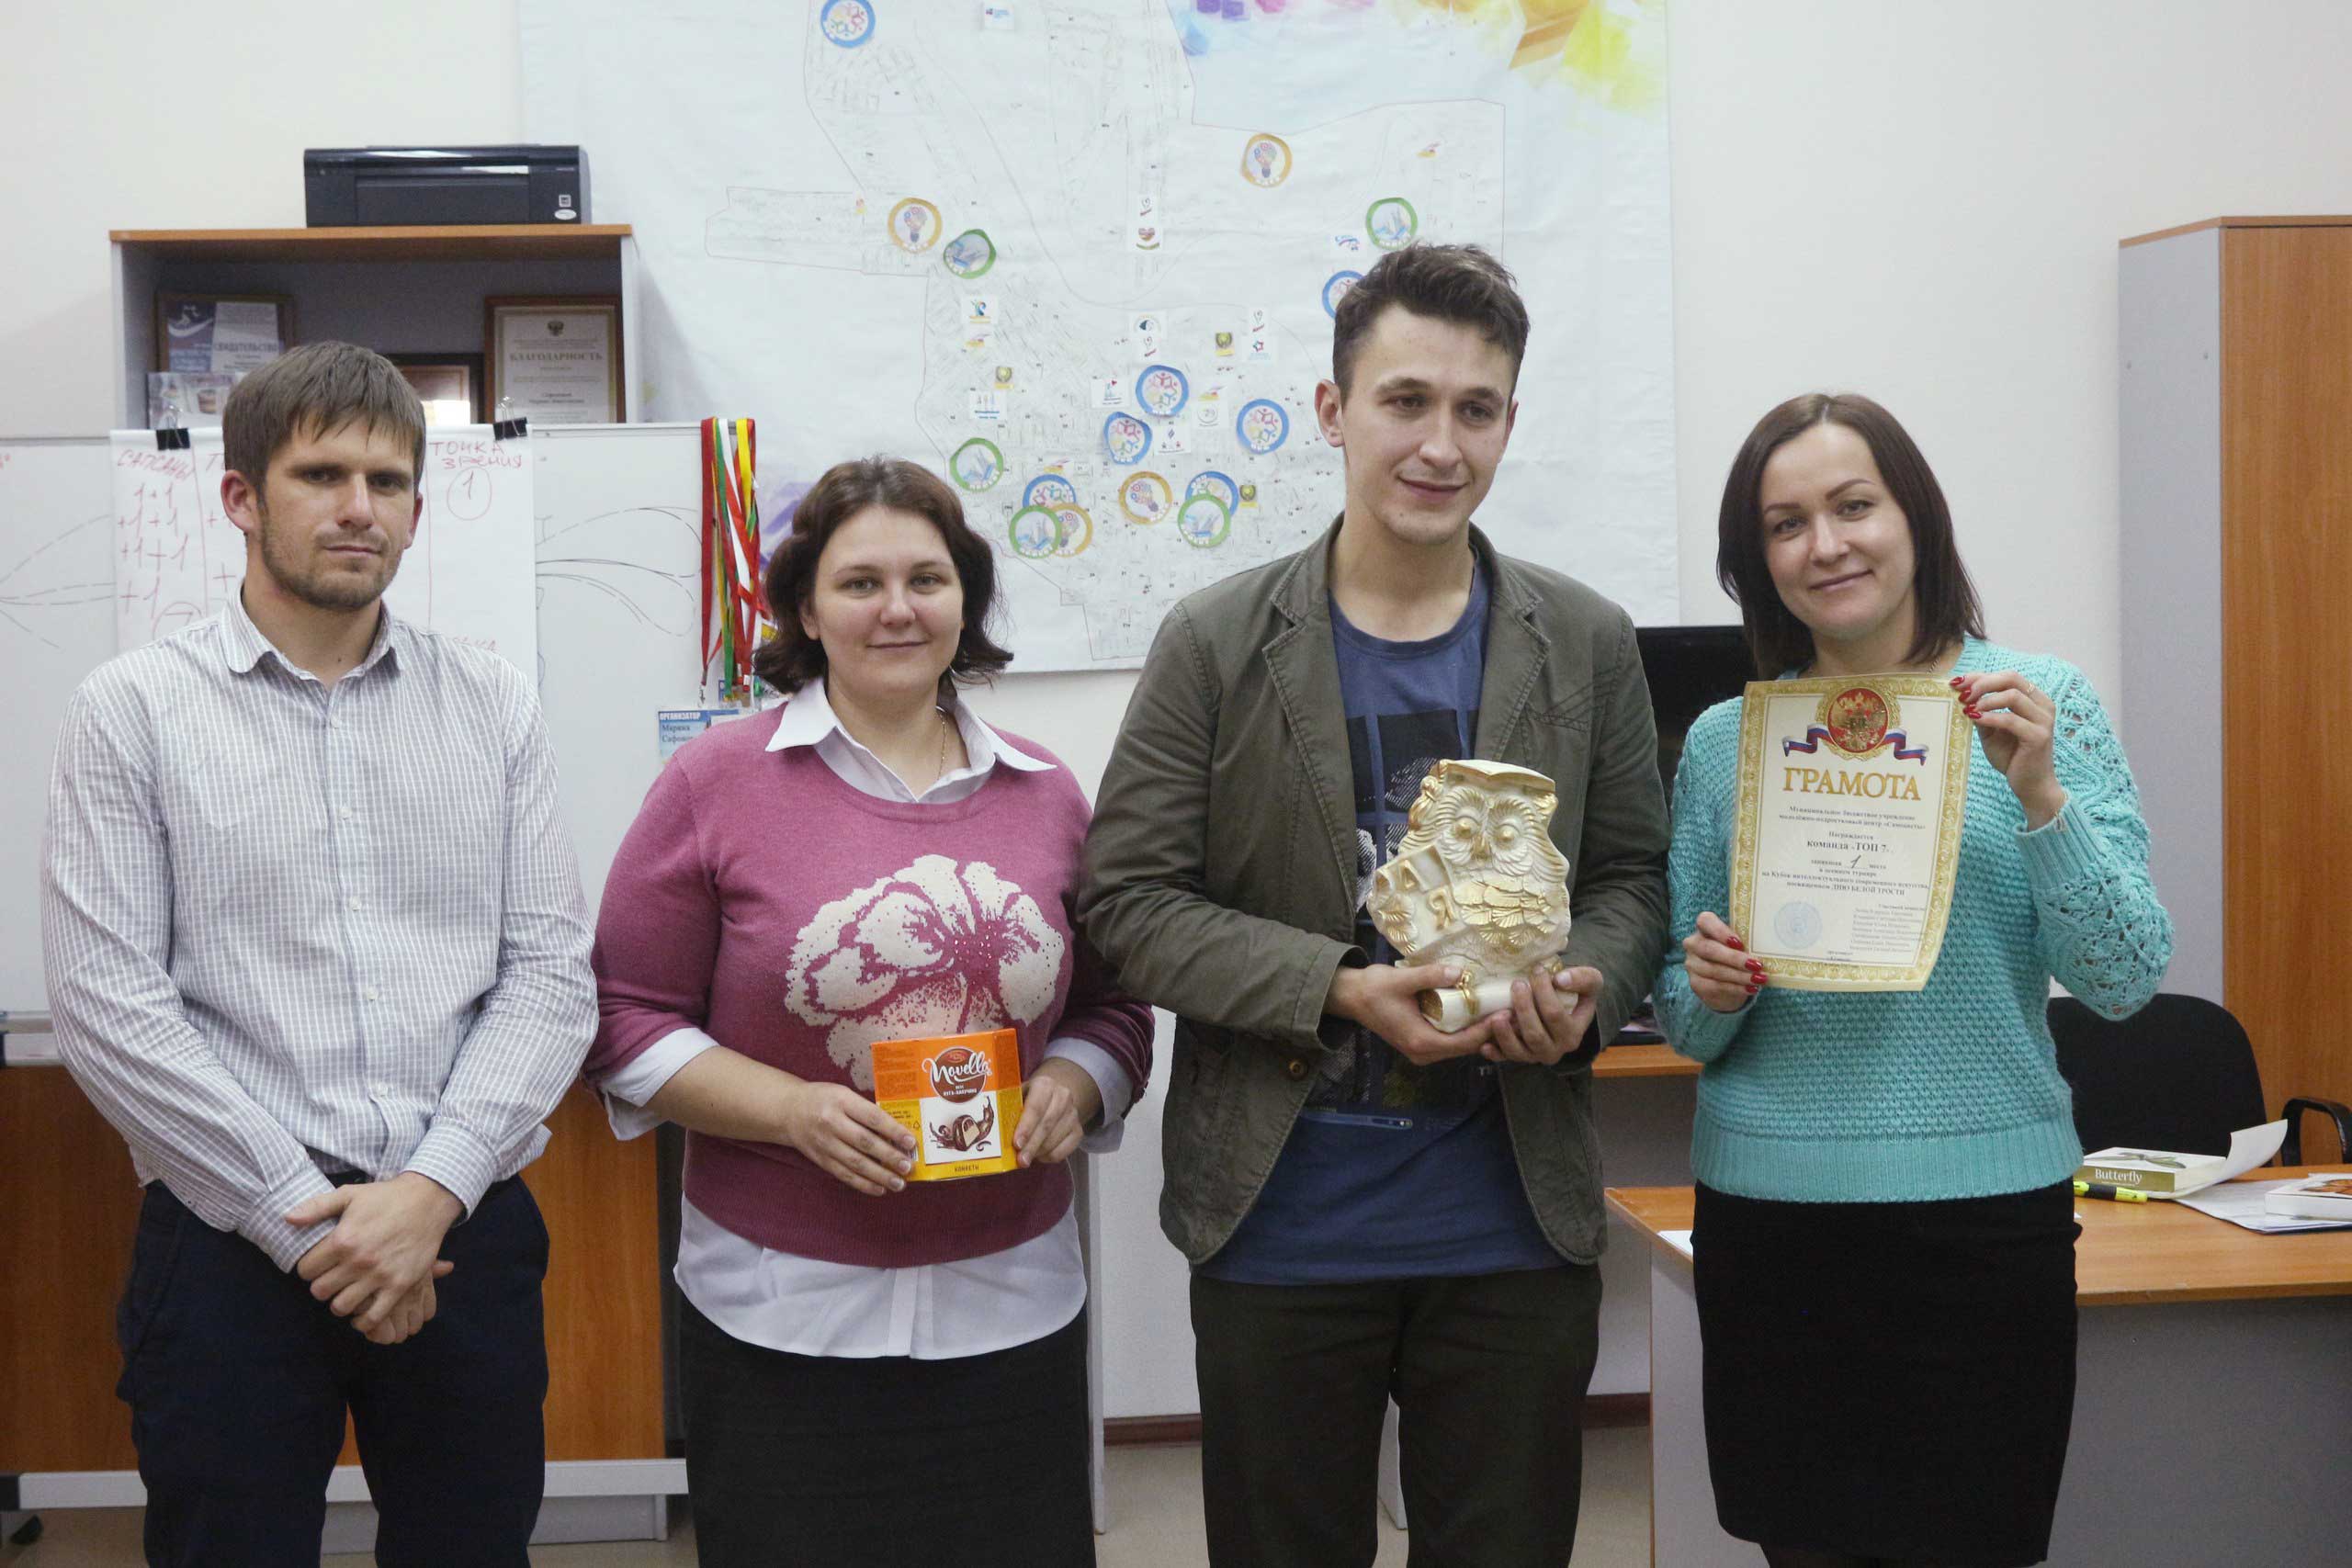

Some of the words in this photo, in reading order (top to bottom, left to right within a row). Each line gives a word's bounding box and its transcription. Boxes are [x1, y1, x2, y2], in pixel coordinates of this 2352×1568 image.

[510, 353, 603, 362] БЛАГОДАРНОСТЬ
[428, 440, 505, 456] ТОЧКА
[442, 455, 522, 470] ЗРЕНИЯ
[662, 724, 691, 733] Марина
[1781, 767, 1922, 802] ГРАМОТА
[1807, 840, 1849, 851] команда
[1850, 854, 1861, 869] 1
[1771, 871, 1791, 879] Кубок
[921, 1051, 993, 1086] Novella
[955, 1165, 979, 1174] КОНФЕТЫ
[2095, 1168, 2143, 1185] Butterfly
